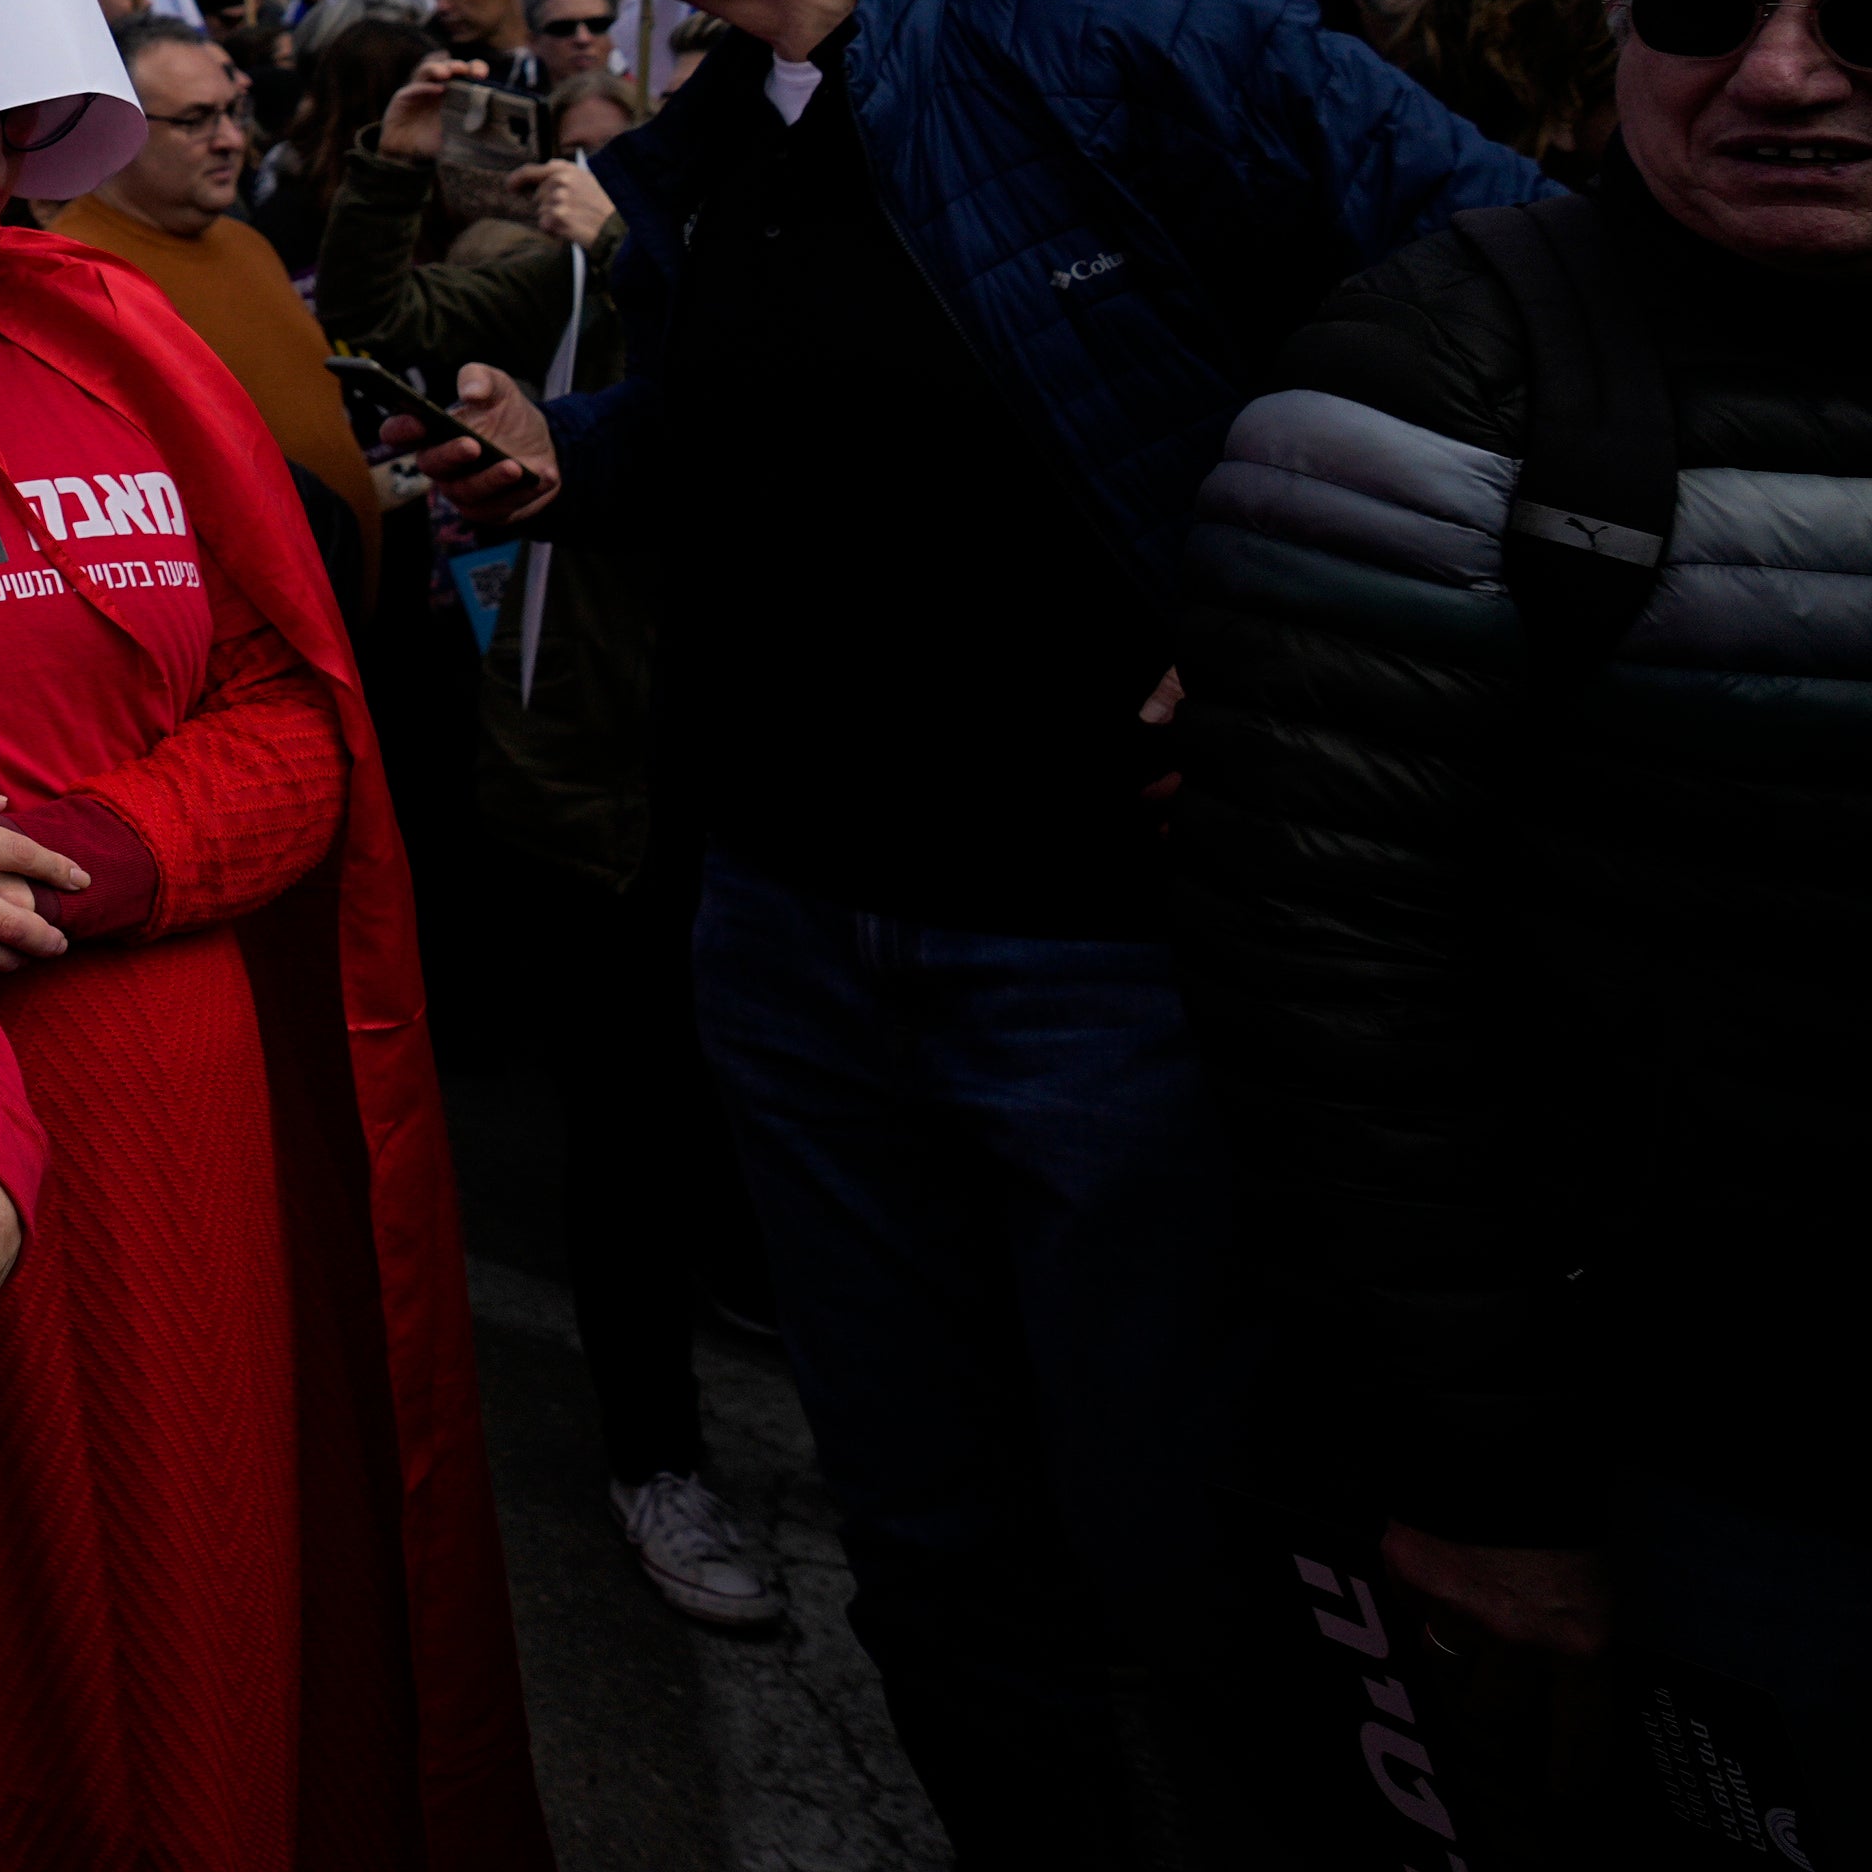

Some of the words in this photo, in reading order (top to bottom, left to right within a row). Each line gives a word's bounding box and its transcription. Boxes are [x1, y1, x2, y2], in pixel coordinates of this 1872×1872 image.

[1070, 252, 1126, 281] Colu
[14, 471, 187, 552] מאבק
[73, 561, 155, 592] בזכויו
[154, 560, 200, 588] פגיעה
